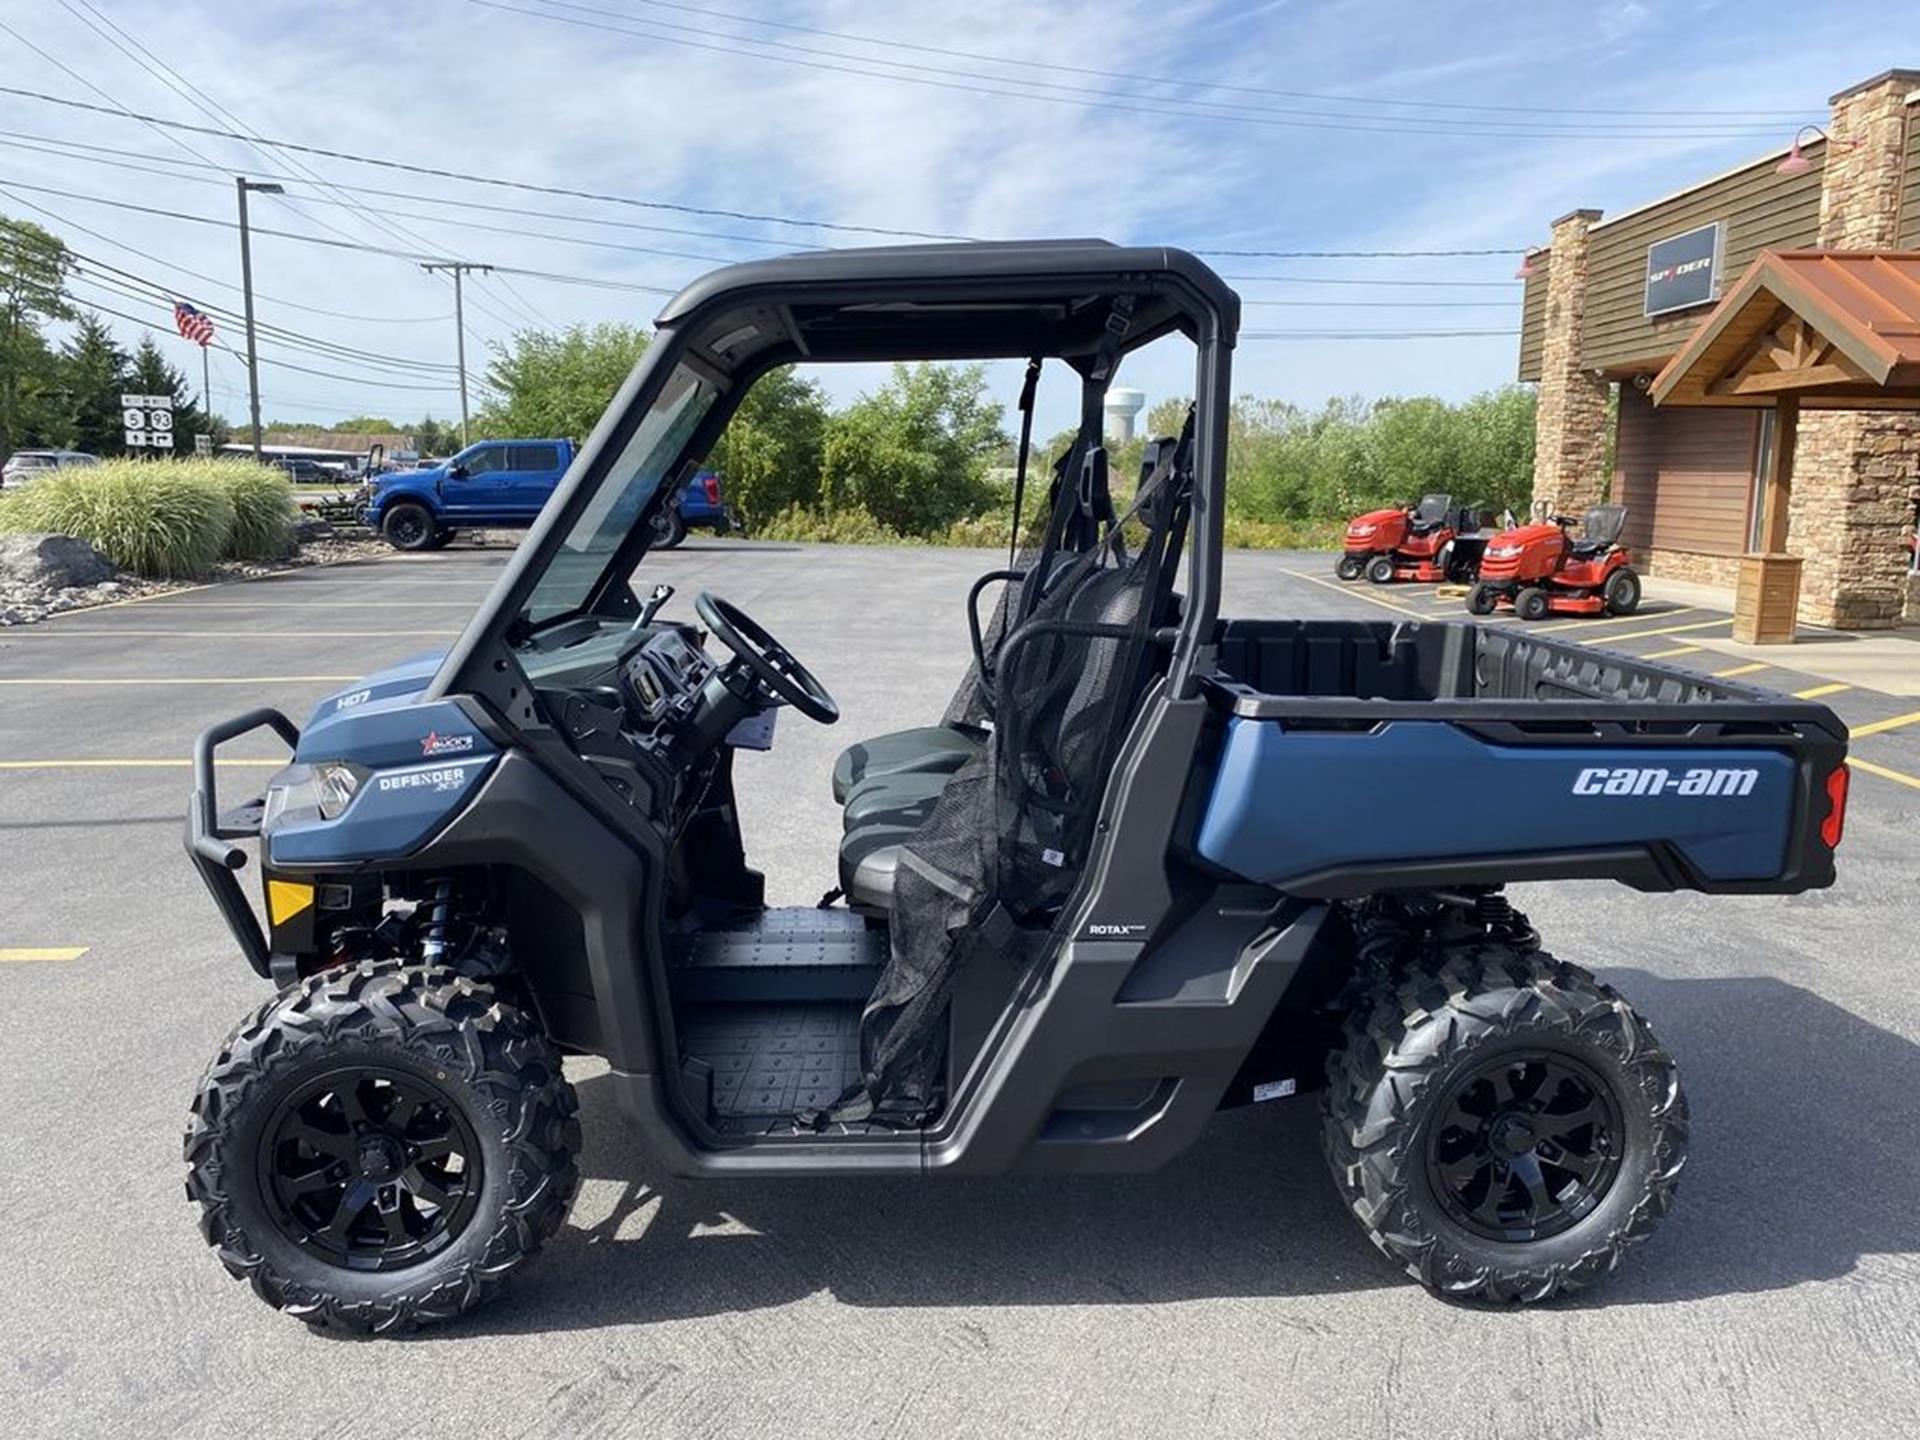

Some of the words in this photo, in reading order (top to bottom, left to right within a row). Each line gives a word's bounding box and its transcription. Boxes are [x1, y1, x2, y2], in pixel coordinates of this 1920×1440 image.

[129, 413, 140, 427] 5
[153, 413, 171, 428] 93
[337, 689, 371, 709] HD7
[380, 768, 465, 790] DEFENDER
[1090, 925, 1130, 935] ROTAX
